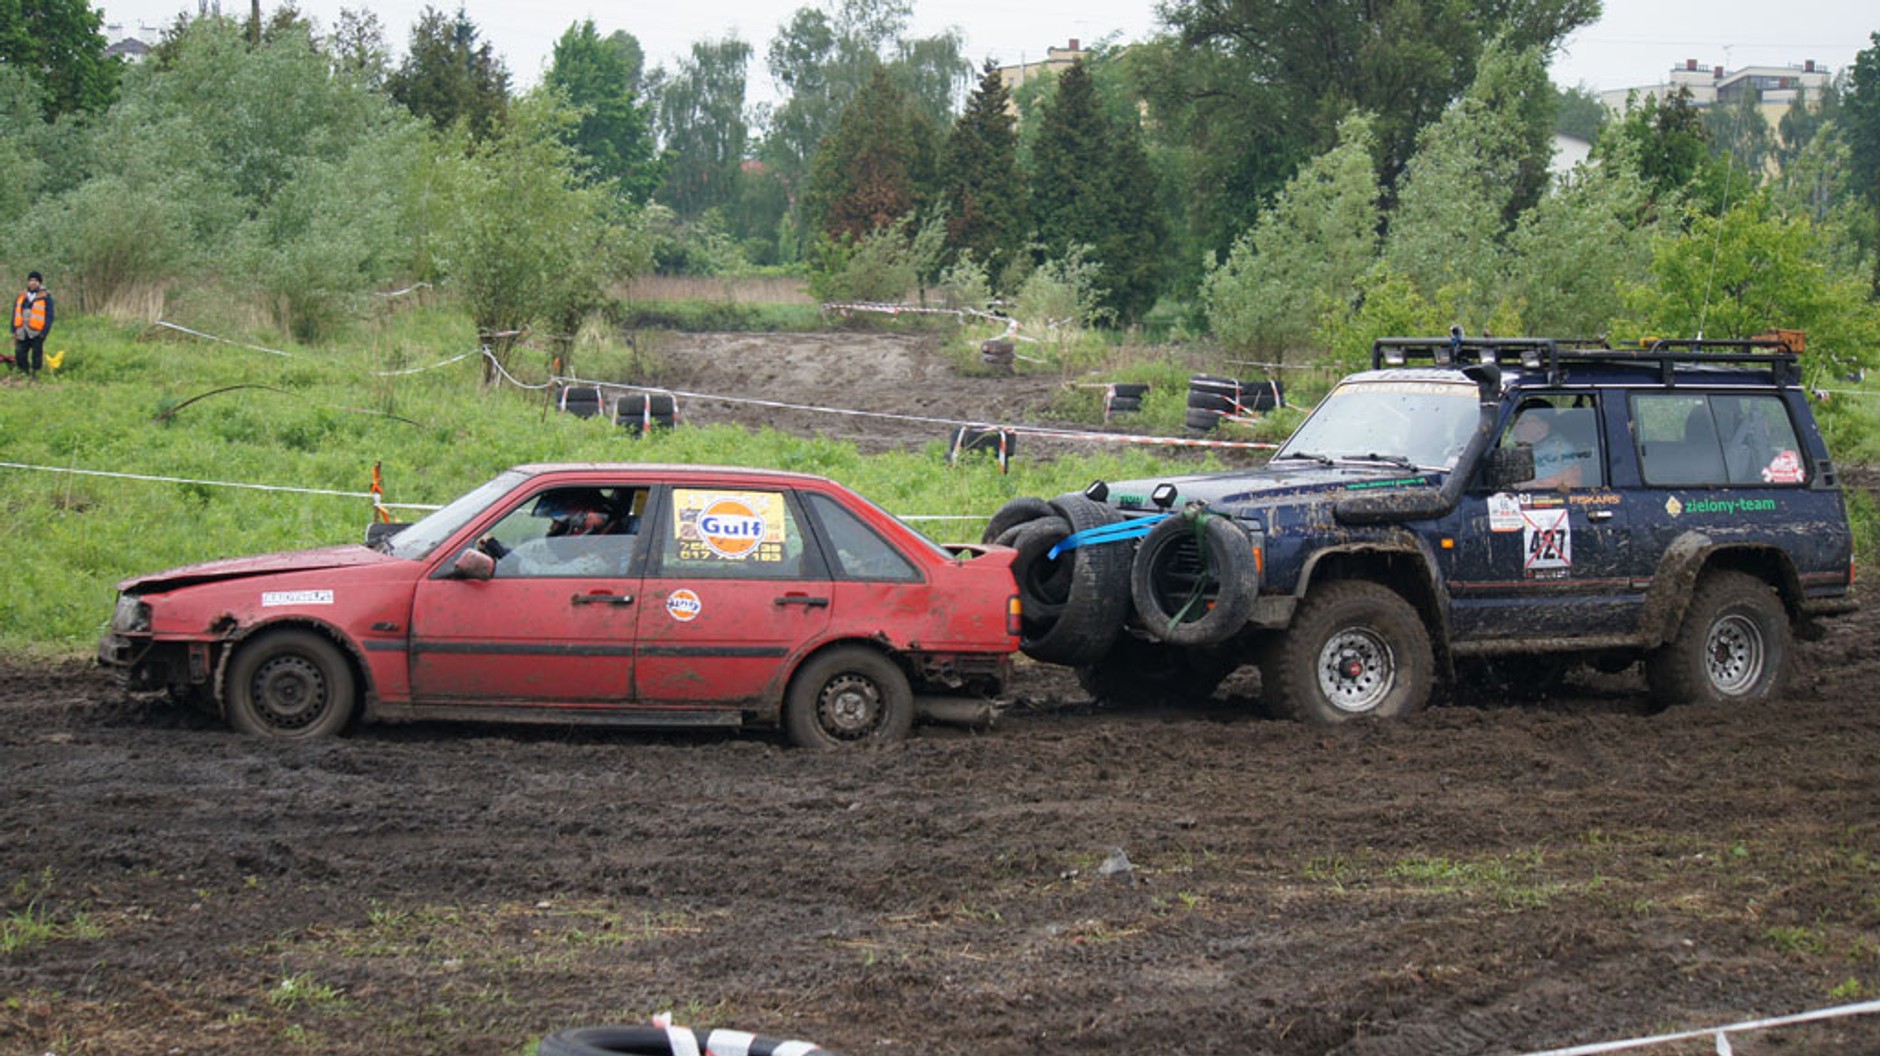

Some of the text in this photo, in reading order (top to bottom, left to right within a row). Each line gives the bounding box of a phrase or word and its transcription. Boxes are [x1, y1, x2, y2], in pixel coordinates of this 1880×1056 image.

[1569, 494, 1622, 505] FISKARS
[1684, 498, 1776, 514] zielony-team
[701, 517, 762, 536] Gulf
